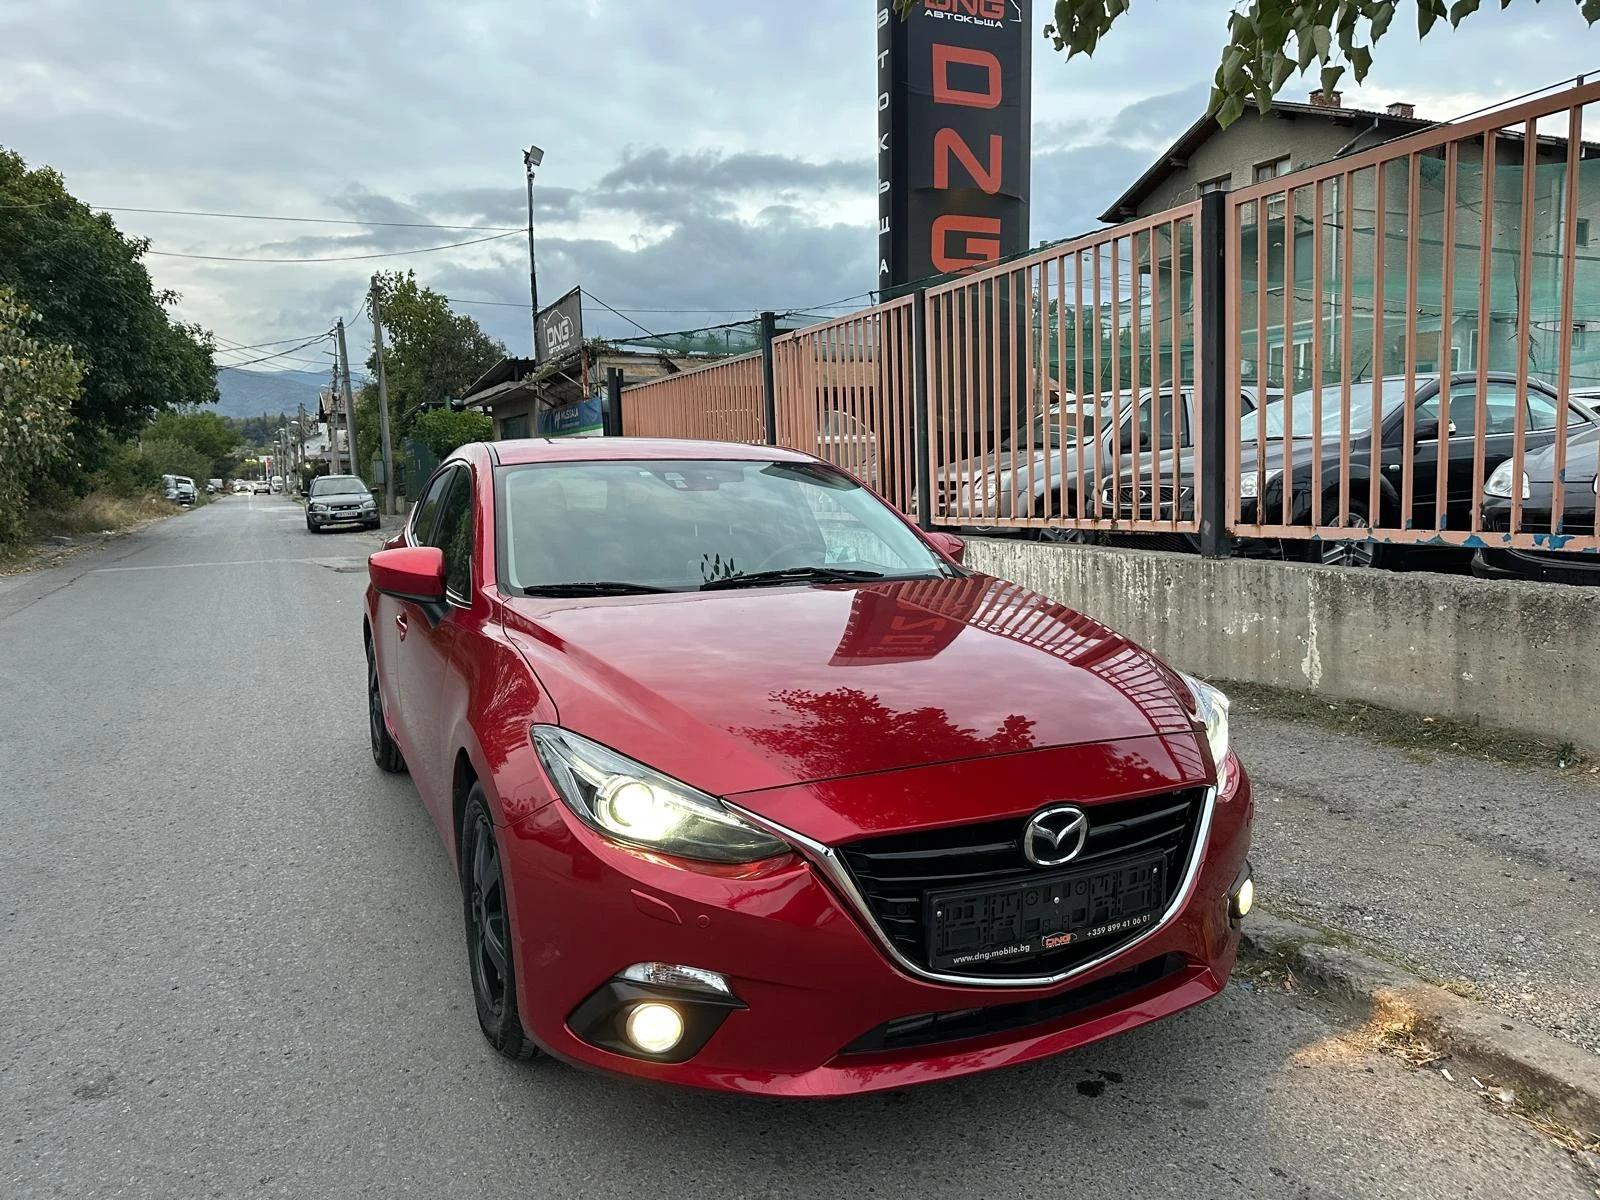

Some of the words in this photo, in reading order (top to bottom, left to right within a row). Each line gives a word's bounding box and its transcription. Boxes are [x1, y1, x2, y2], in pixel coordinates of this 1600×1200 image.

[931, 43, 1003, 275] DNG
[547, 319, 569, 348] DNG
[1086, 926, 1106, 937] +359
[1107, 922, 1121, 932] 899
[1122, 919, 1130, 928] 41
[1132, 917, 1141, 925] 06
[1142, 913, 1151, 923] 01
[1046, 934, 1071, 946] DNG
[953, 944, 1031, 964] www.dng.mobile.bg
